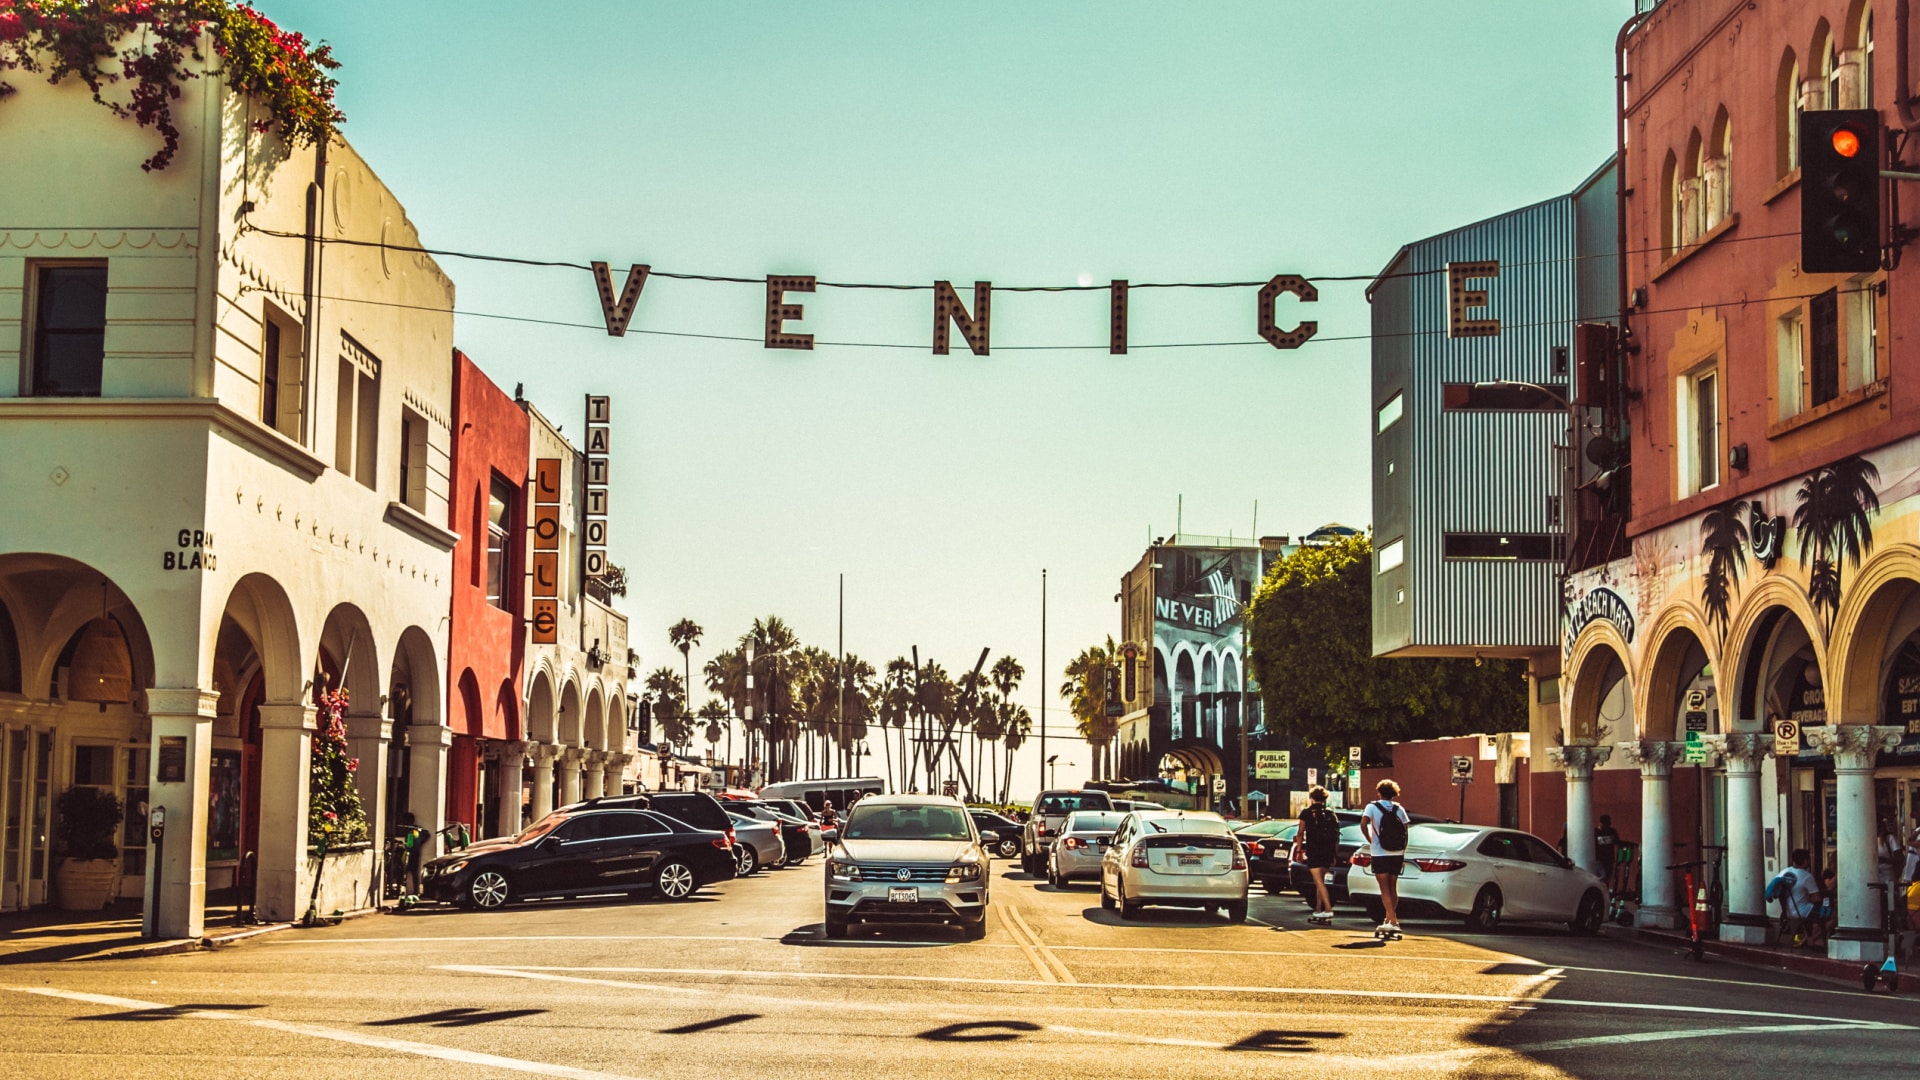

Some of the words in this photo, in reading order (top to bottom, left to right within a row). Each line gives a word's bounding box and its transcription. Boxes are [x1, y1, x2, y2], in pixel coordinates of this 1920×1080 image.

[590, 260, 1501, 356] VENICE
[588, 399, 606, 573] TATTOO
[163, 550, 217, 571] BLANCO
[1155, 596, 1212, 628] NEVER
[1583, 590, 1608, 620] BEACH
[1610, 595, 1632, 641] MART
[1902, 699, 1918, 713] EBT
[1259, 754, 1286, 762] PUBLIC
